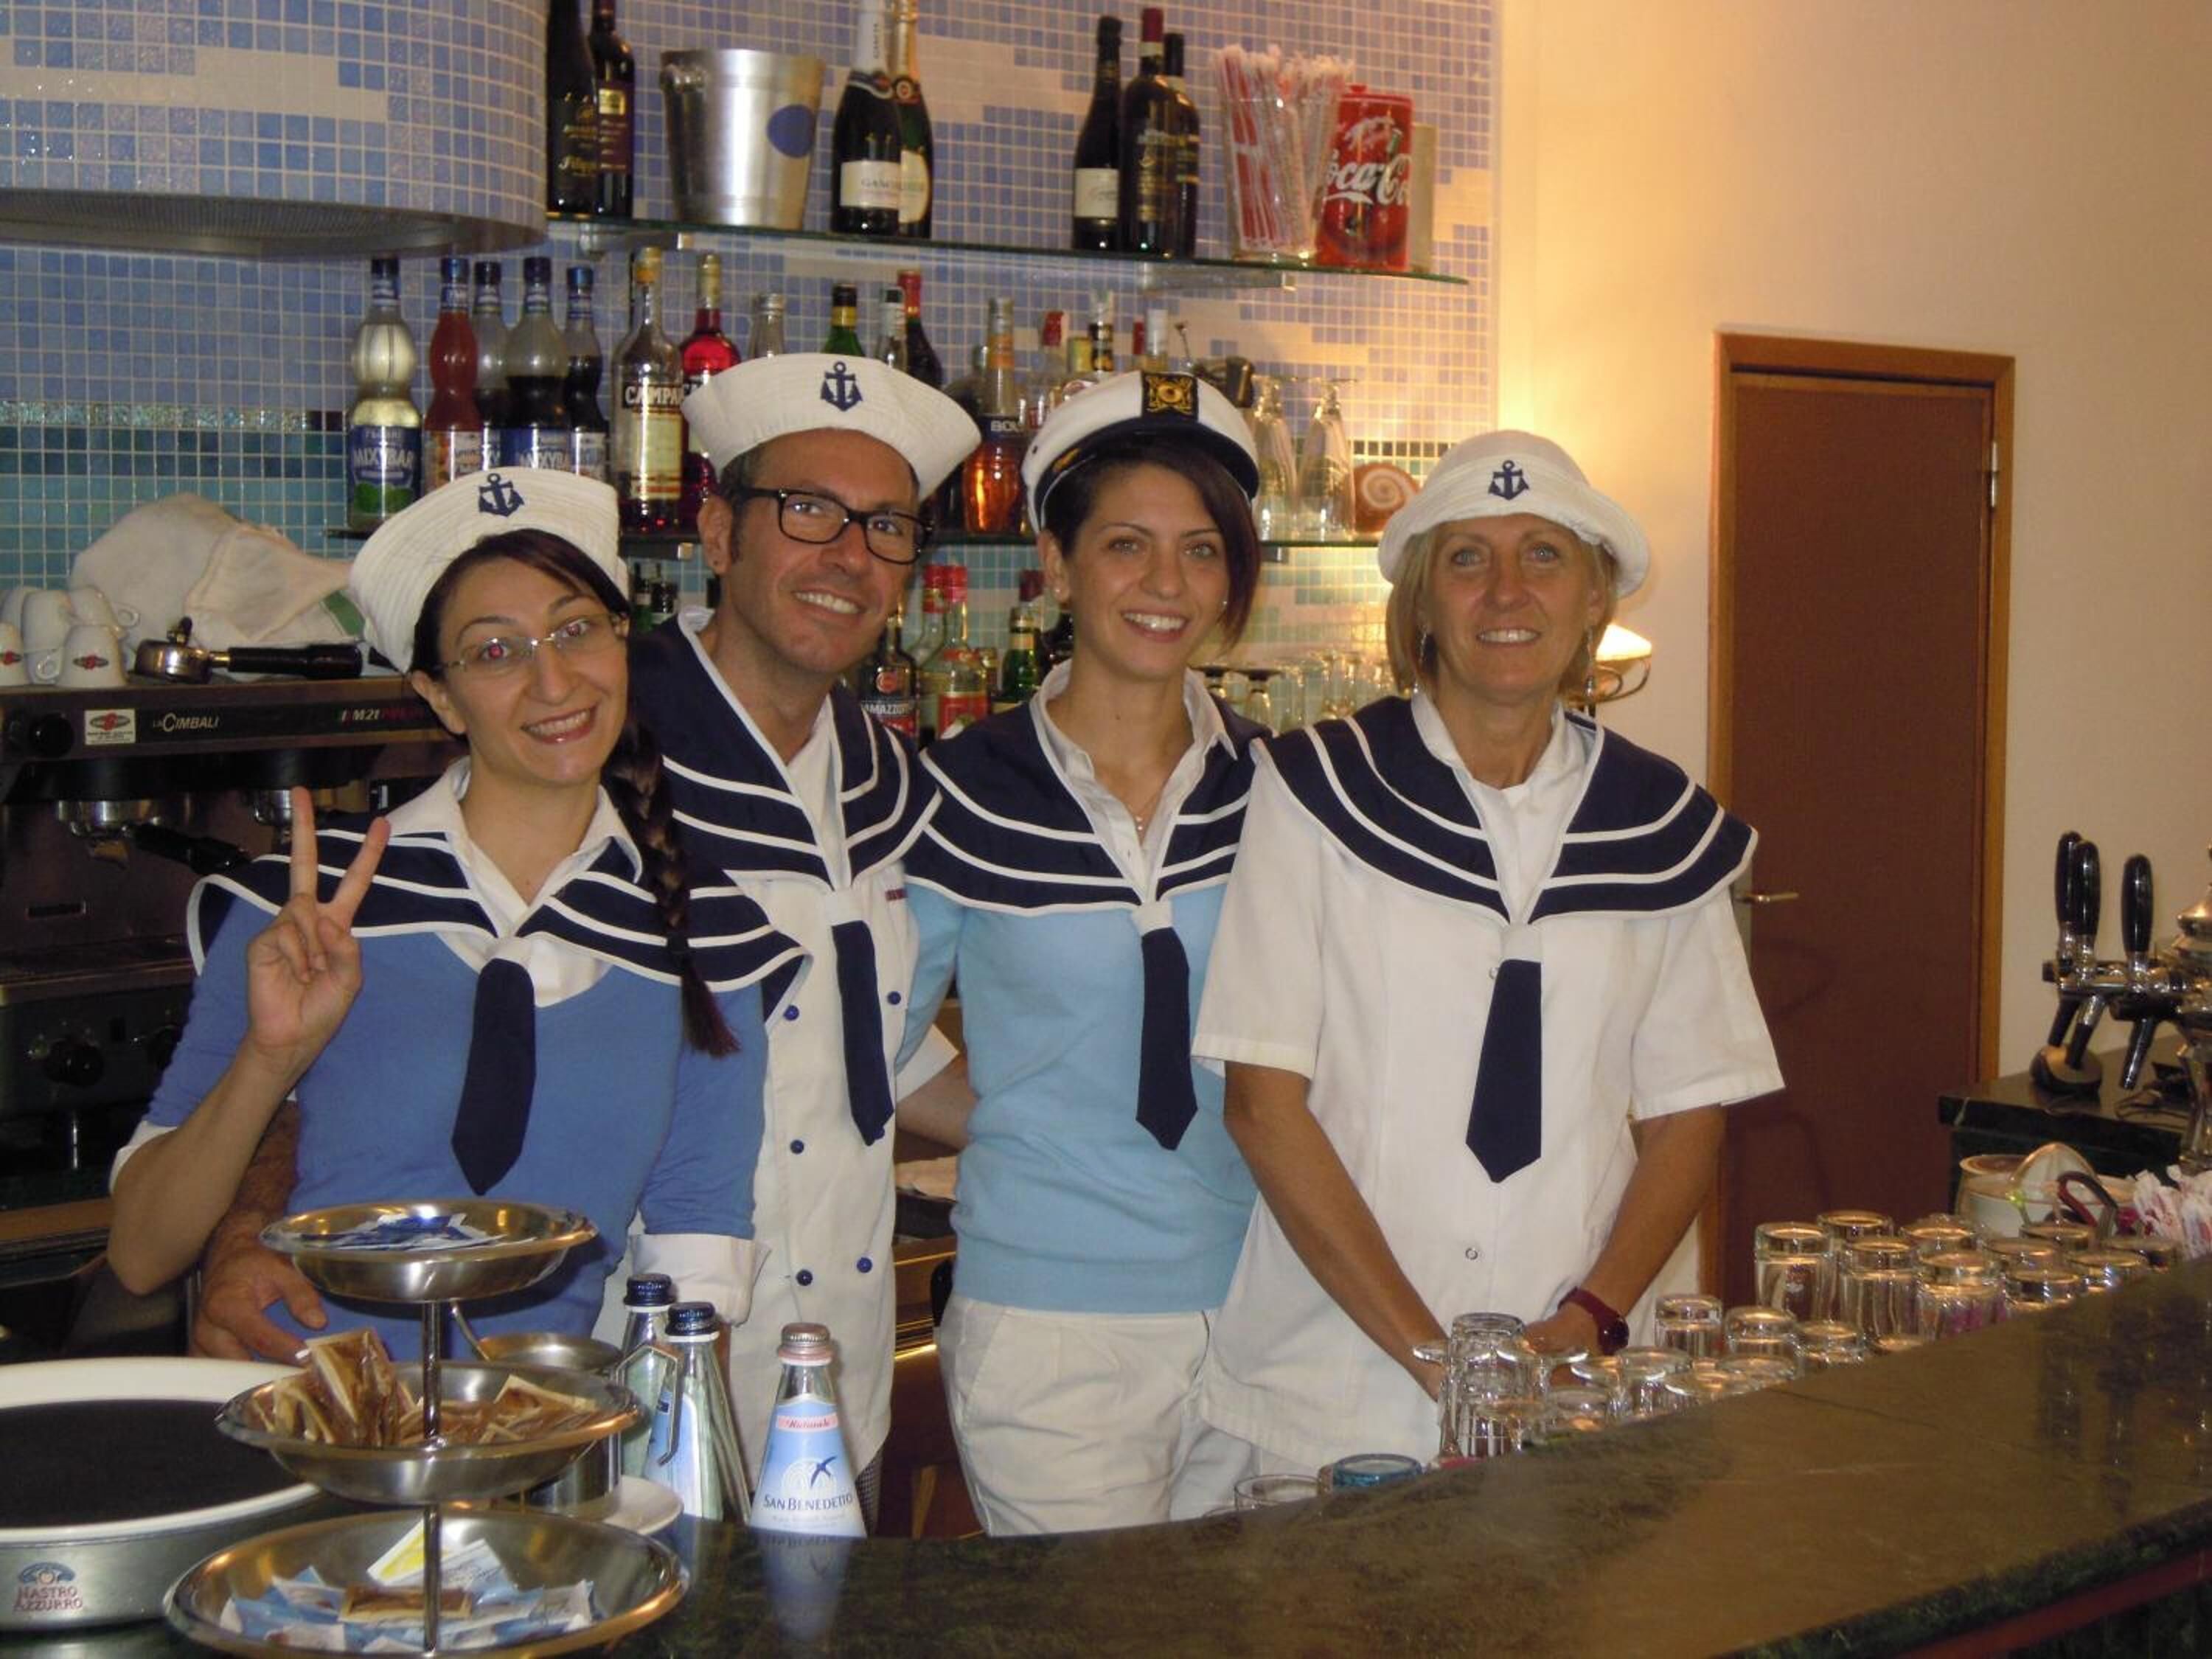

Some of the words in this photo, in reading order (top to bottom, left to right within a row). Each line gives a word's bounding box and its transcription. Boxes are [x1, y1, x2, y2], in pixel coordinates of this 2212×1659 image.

[163, 712, 219, 732] CIMBALI
[763, 1494, 785, 1510] SAN
[787, 1492, 854, 1511] BENEDETTO
